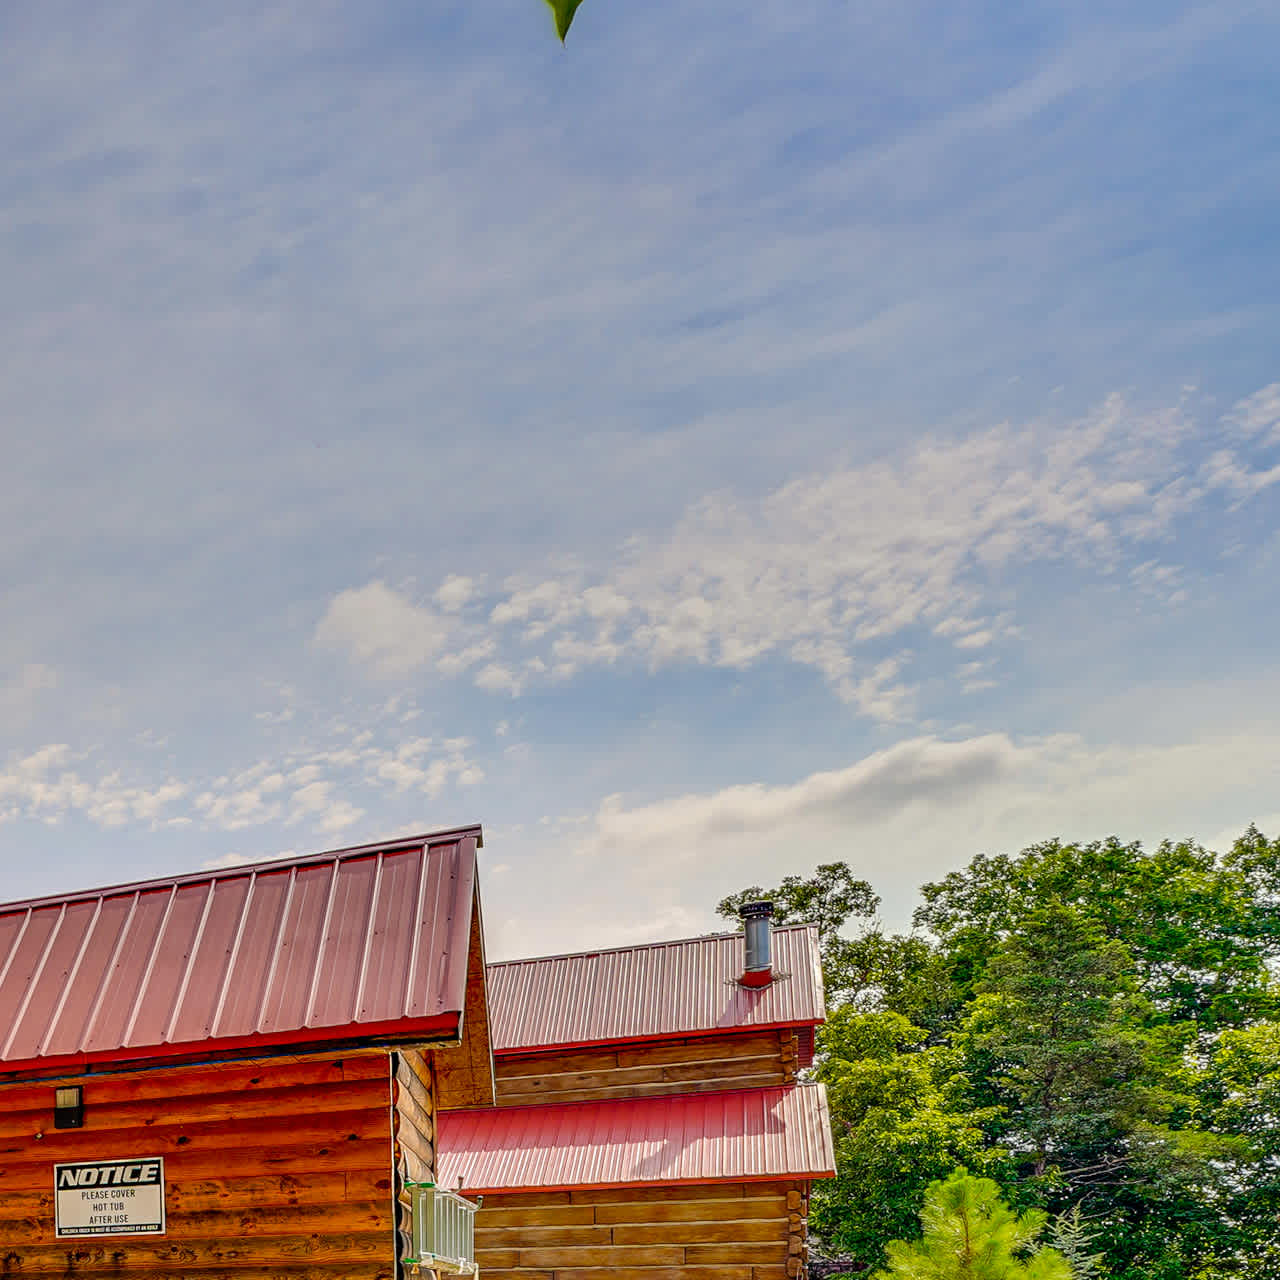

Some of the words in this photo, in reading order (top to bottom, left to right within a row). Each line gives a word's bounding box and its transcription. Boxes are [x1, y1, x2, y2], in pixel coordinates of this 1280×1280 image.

[59, 1164, 159, 1187] NOTICE
[81, 1191, 109, 1200] PLEASE
[110, 1189, 136, 1199] COVER
[92, 1203, 107, 1212] HOT
[109, 1202, 125, 1211] TUB
[89, 1215, 113, 1225] AFTER
[114, 1214, 129, 1223] USE
